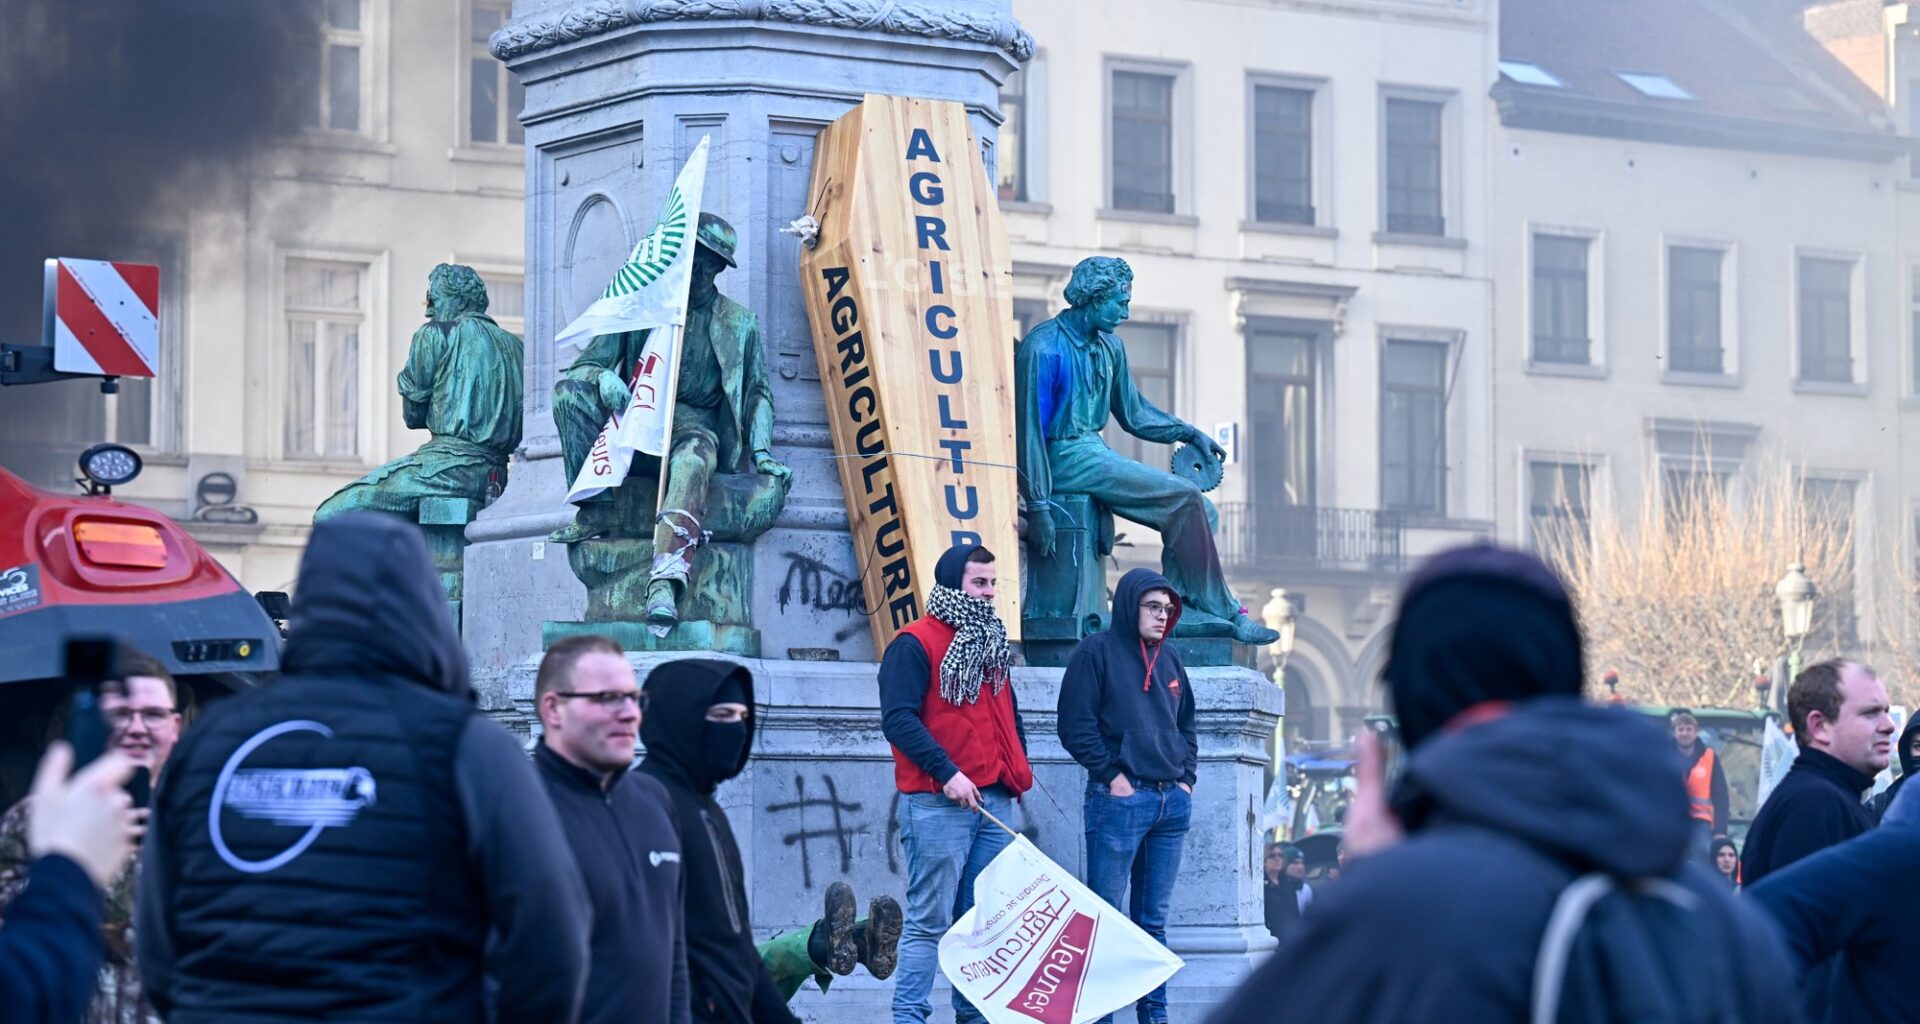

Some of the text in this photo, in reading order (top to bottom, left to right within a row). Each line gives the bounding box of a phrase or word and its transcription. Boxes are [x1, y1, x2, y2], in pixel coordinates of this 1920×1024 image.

[822, 266, 919, 631] AGRICULTURE
[1006, 899, 1018, 911] se
[1016, 873, 1051, 901] Demain
[960, 900, 1060, 982] Agriculteurs
[1022, 935, 1086, 1014] Jeunes
